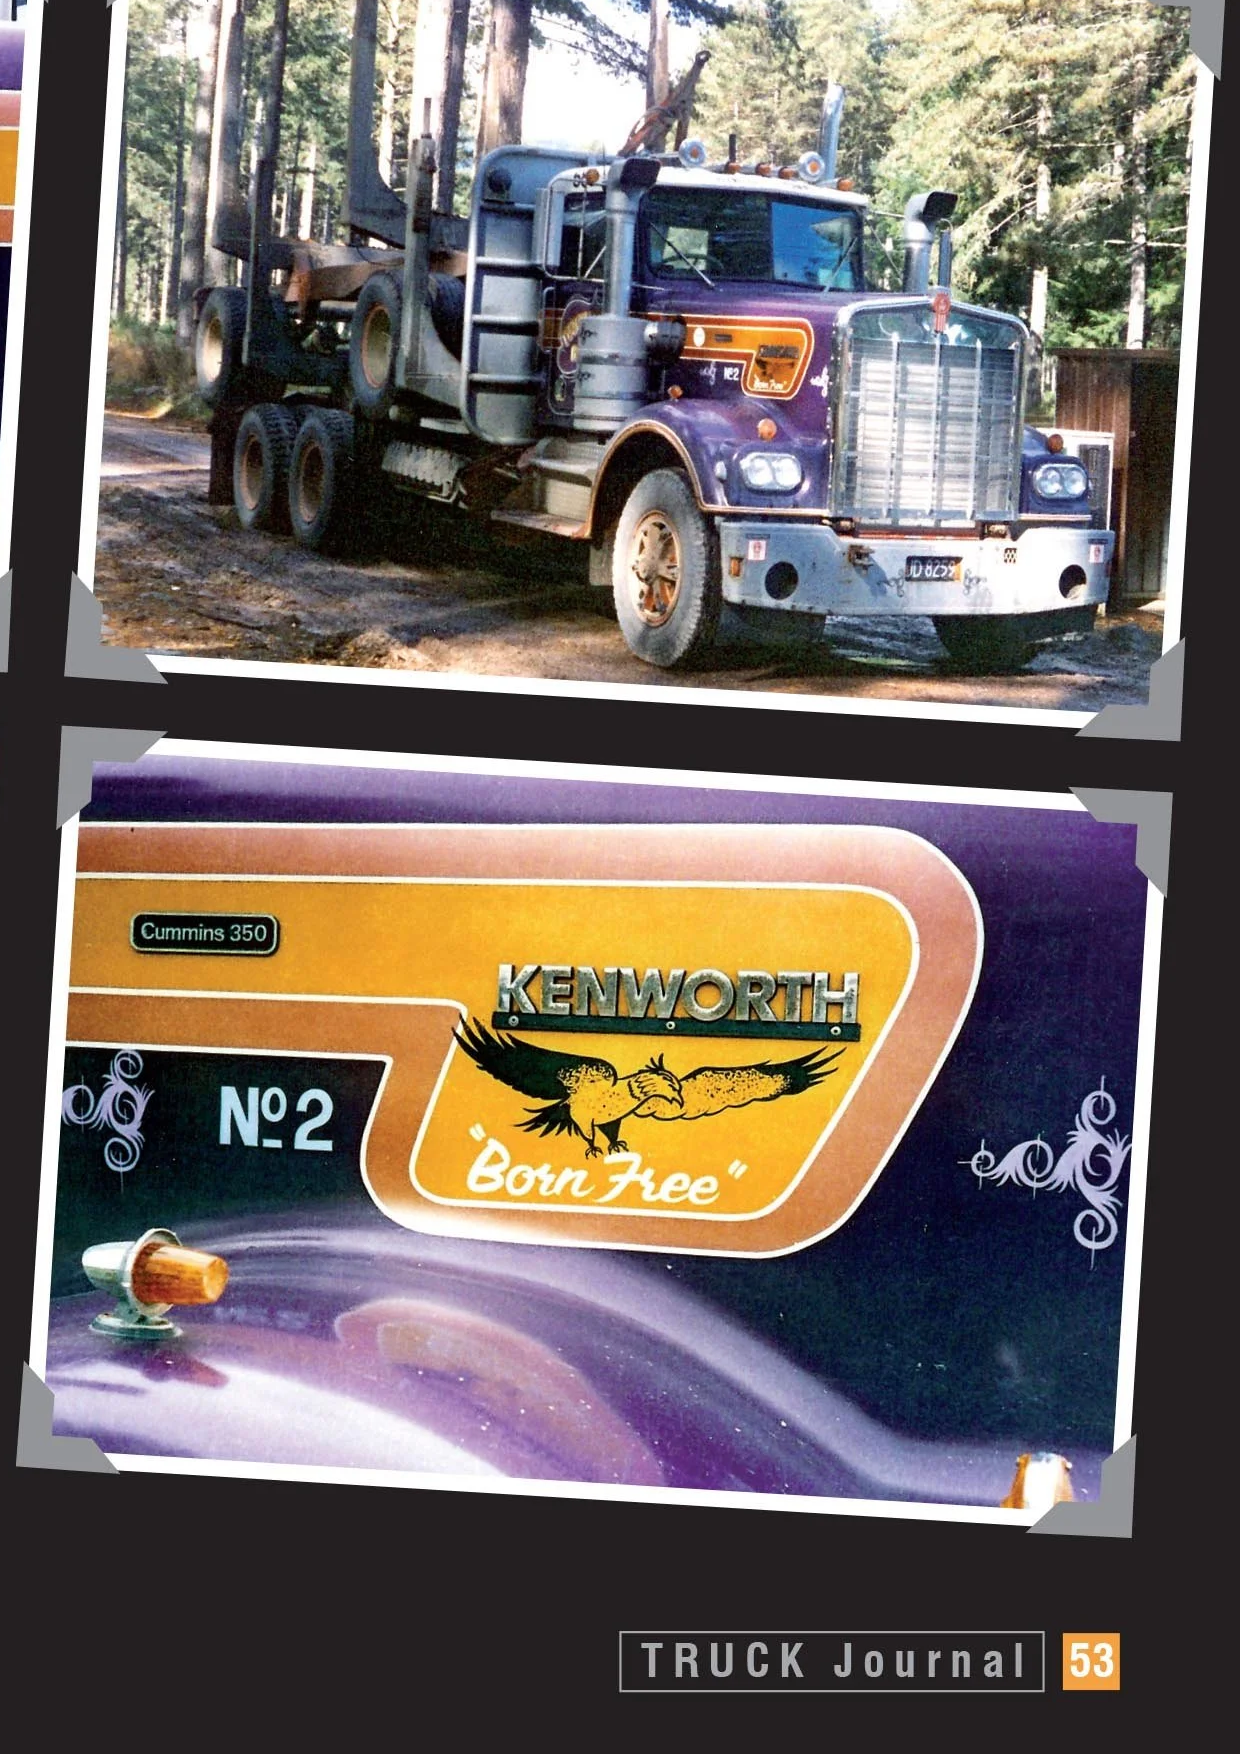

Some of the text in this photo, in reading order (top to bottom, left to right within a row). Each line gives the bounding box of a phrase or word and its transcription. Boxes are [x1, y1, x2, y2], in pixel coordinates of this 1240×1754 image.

[140, 922, 267, 942] Cummins 350
[497, 964, 861, 1024] KENWORTH
[294, 1088, 334, 1151] 2
